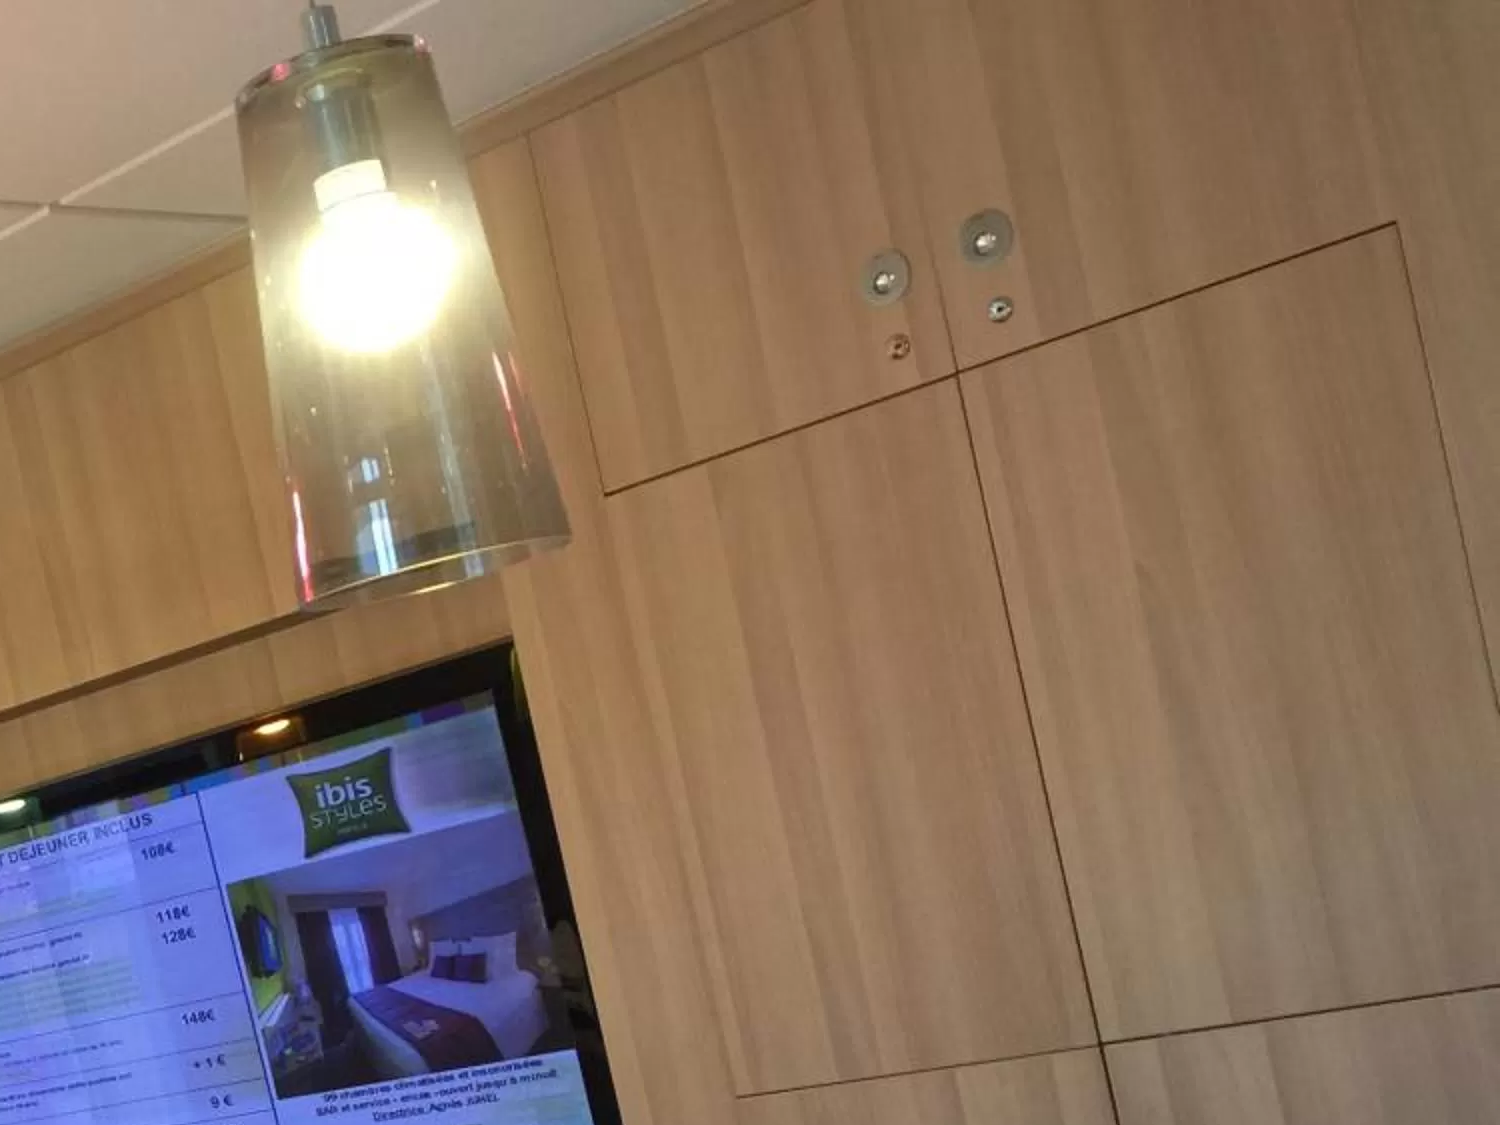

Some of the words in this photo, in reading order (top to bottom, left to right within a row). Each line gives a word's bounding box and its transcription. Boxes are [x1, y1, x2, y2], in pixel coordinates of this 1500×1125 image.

[314, 775, 373, 808] ibis
[7, 830, 90, 864] DEJEUNER
[93, 812, 153, 838] INCLUS
